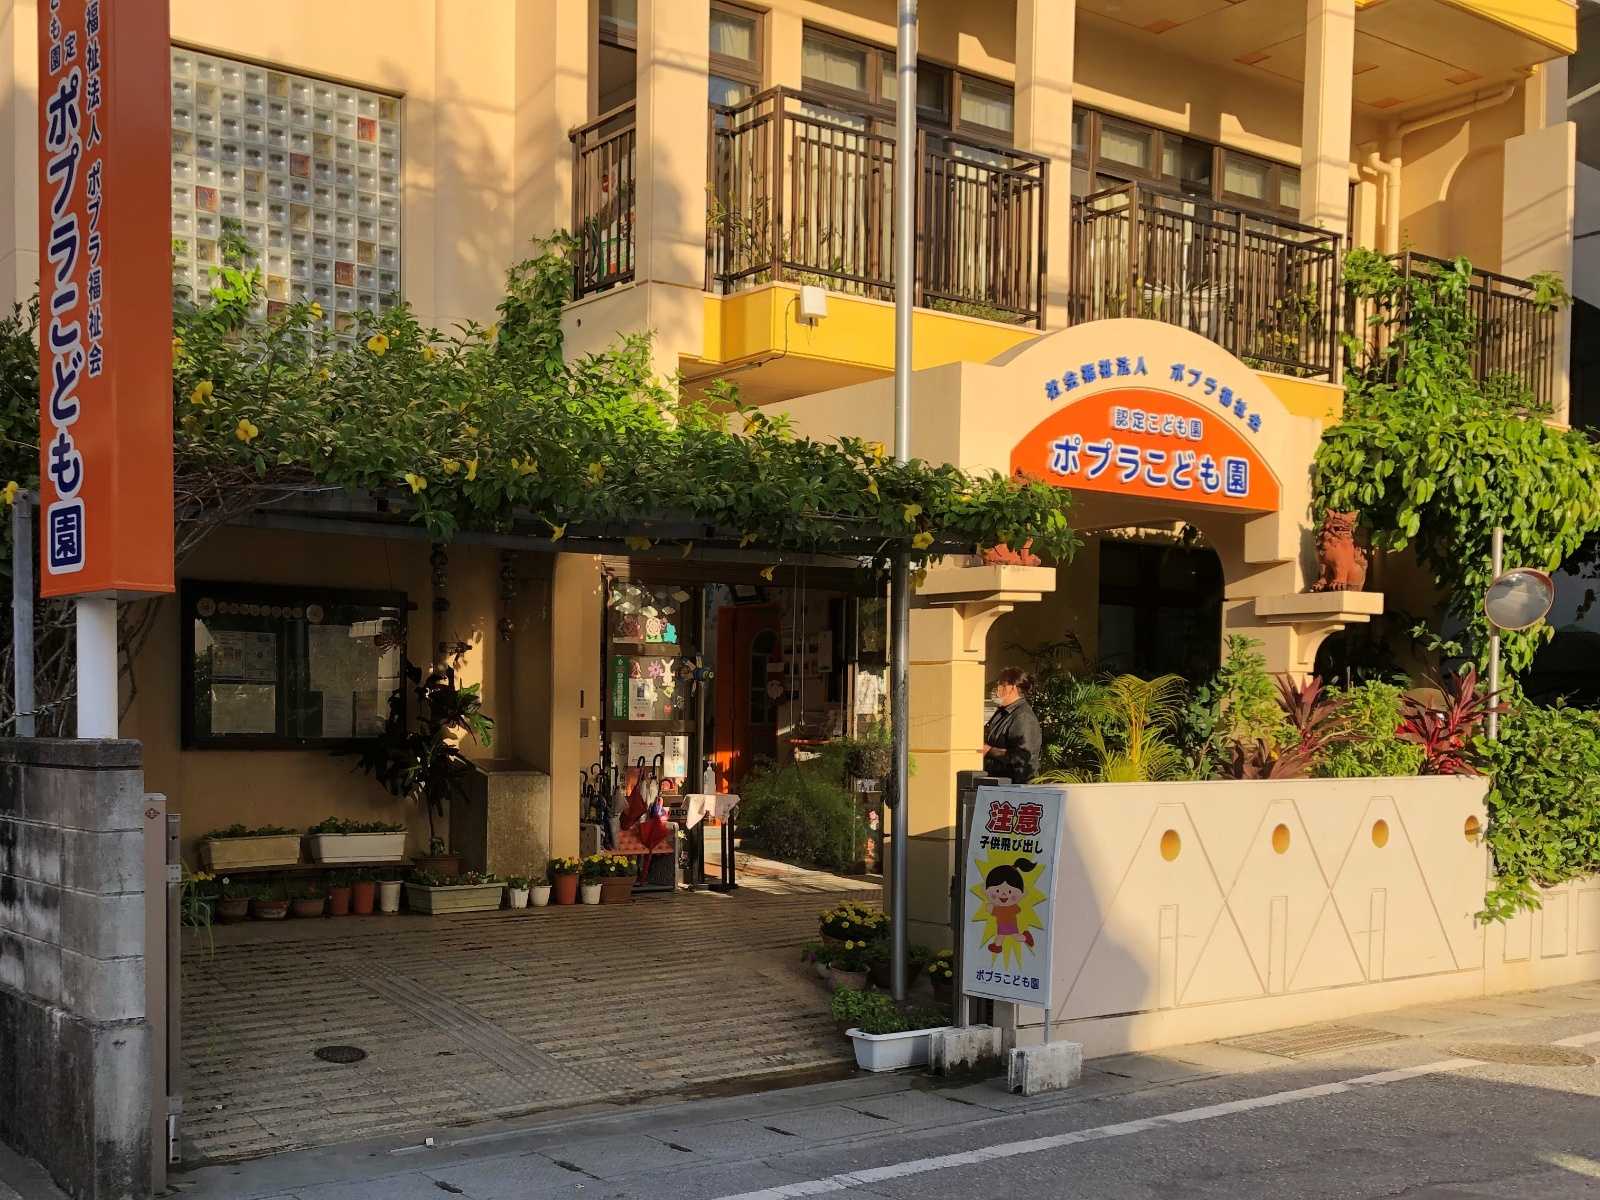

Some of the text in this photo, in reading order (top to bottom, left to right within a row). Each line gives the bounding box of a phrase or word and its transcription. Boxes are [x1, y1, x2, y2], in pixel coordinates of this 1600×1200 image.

[64, 32, 76, 62] 定
[88, 162, 102, 376] ポプラ福祉会
[49, 70, 83, 570] ポプラこども園
[1045, 356, 1262, 434] 社会福祉法人 ポプラ福祉会
[1115, 408, 1202, 438] 認定こども園
[1053, 436, 1248, 495] ポプラこども園
[985, 801, 1043, 835] 注意
[979, 835, 1043, 854] 子供飛び出し
[976, 969, 1040, 989] ポプラこども園
